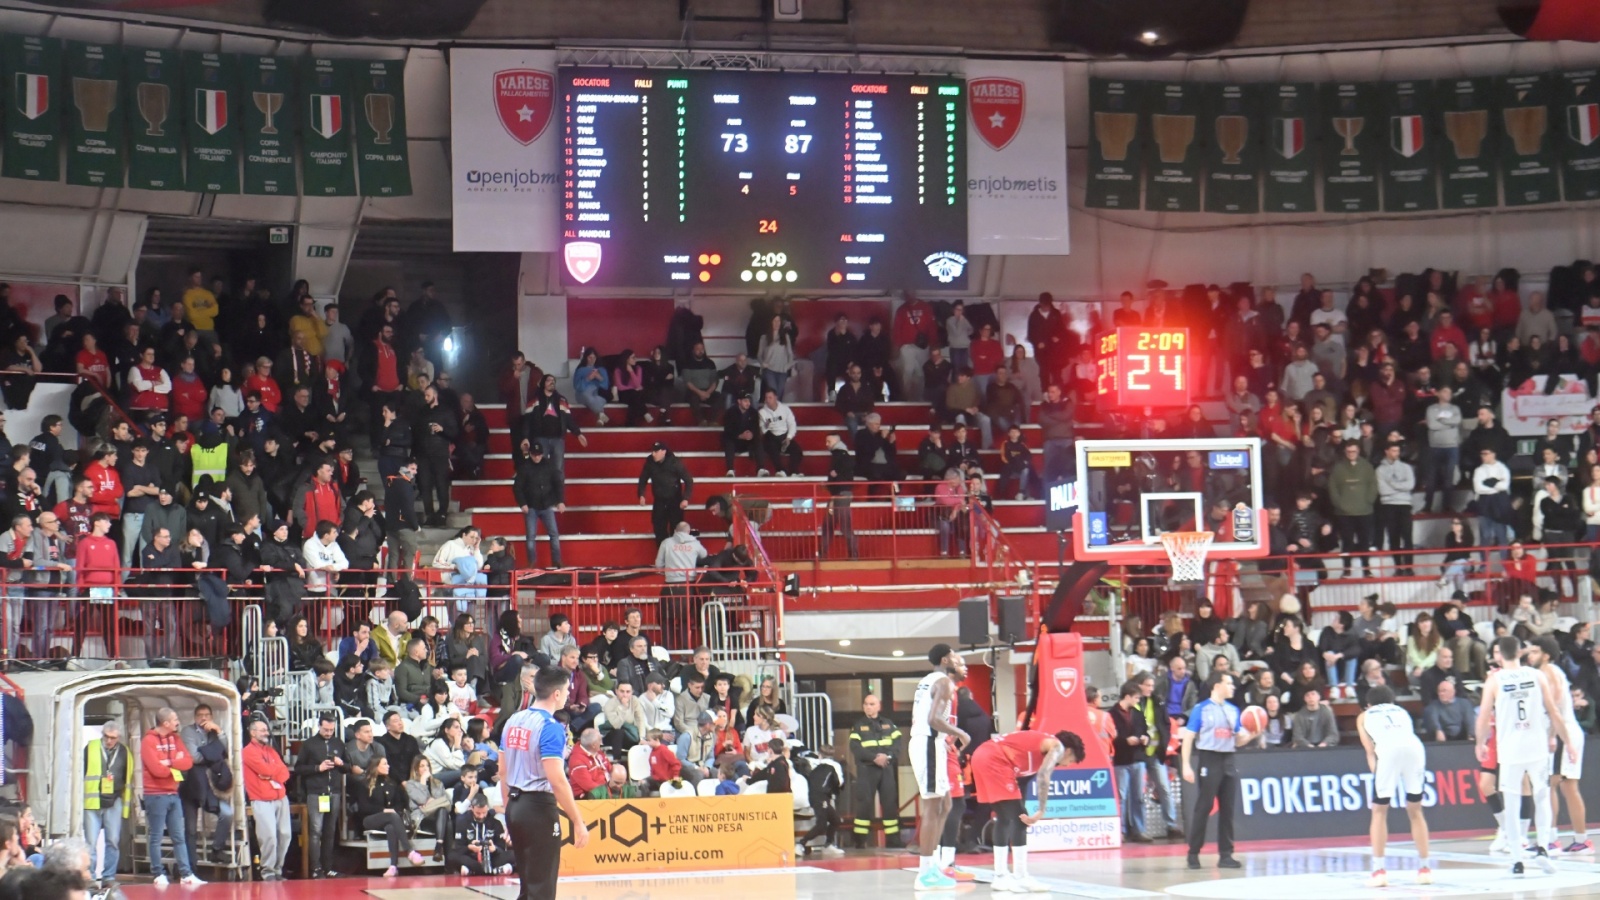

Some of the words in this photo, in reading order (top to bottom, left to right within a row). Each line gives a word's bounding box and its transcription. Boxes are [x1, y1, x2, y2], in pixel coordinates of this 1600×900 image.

[499, 75, 550, 90] VARESE
[573, 78, 610, 87] GIOCATORE
[634, 79, 653, 88] FALLI
[667, 79, 688, 88] PUNTI
[851, 85, 888, 94] GIOCATORE
[972, 83, 1020, 98] VARESE
[677, 107, 686, 116] 16
[677, 128, 686, 136] 17
[720, 133, 749, 153] 73
[784, 134, 813, 154] 87
[565, 148, 573, 156] 13
[642, 149, 648, 157] 4
[565, 169, 573, 177] 19
[565, 180, 574, 188] 24
[643, 180, 648, 189] 1
[947, 175, 954, 184] 7
[741, 184, 750, 195] 4
[789, 185, 797, 195] 5
[919, 196, 924, 205] 1
[679, 203, 685, 212] 7
[565, 213, 574, 221] 92
[643, 213, 648, 222] 1
[759, 220, 778, 233] 24
[564, 230, 576, 238] ALL
[840, 234, 853, 242] ALL
[751, 252, 788, 267] 2:09
[1137, 332, 1185, 351] 2:09
[1098, 355, 1118, 395] 24
[1127, 354, 1182, 390] 24
[1517, 700, 1526, 721] 6
[1032, 780, 1091, 796] IELYUM
[668, 811, 779, 825] L'ANTINFORTUNISTICA
[669, 825, 689, 834] CHE
[692, 824, 713, 834] NON
[717, 822, 744, 833] PESA
[594, 848, 724, 864] www.ariapiu.com
